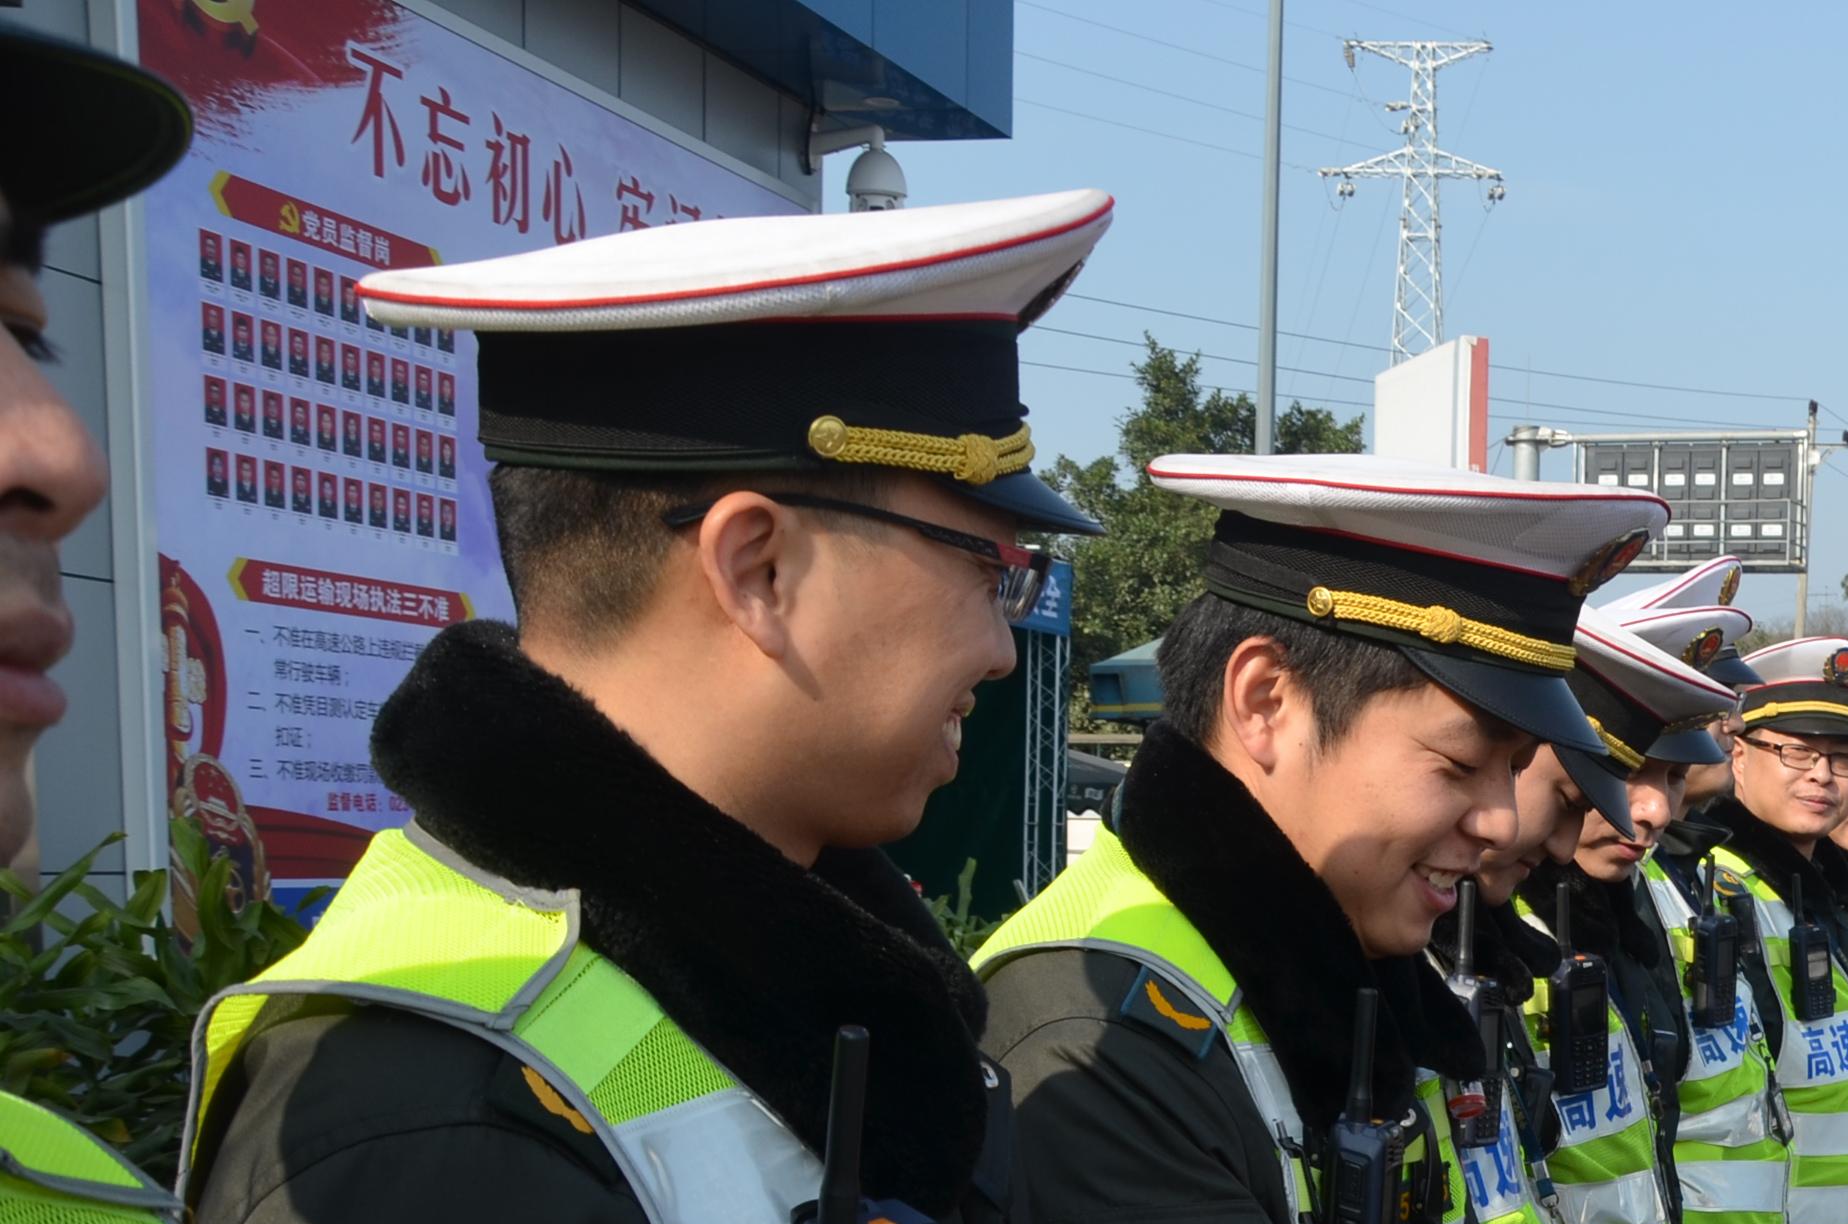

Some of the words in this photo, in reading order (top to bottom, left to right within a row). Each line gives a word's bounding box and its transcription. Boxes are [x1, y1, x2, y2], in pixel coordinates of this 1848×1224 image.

[350, 46, 586, 247] 不忘初心
[302, 210, 390, 266] 党员监督岗
[261, 568, 450, 622] 超限运输现场执法三不准
